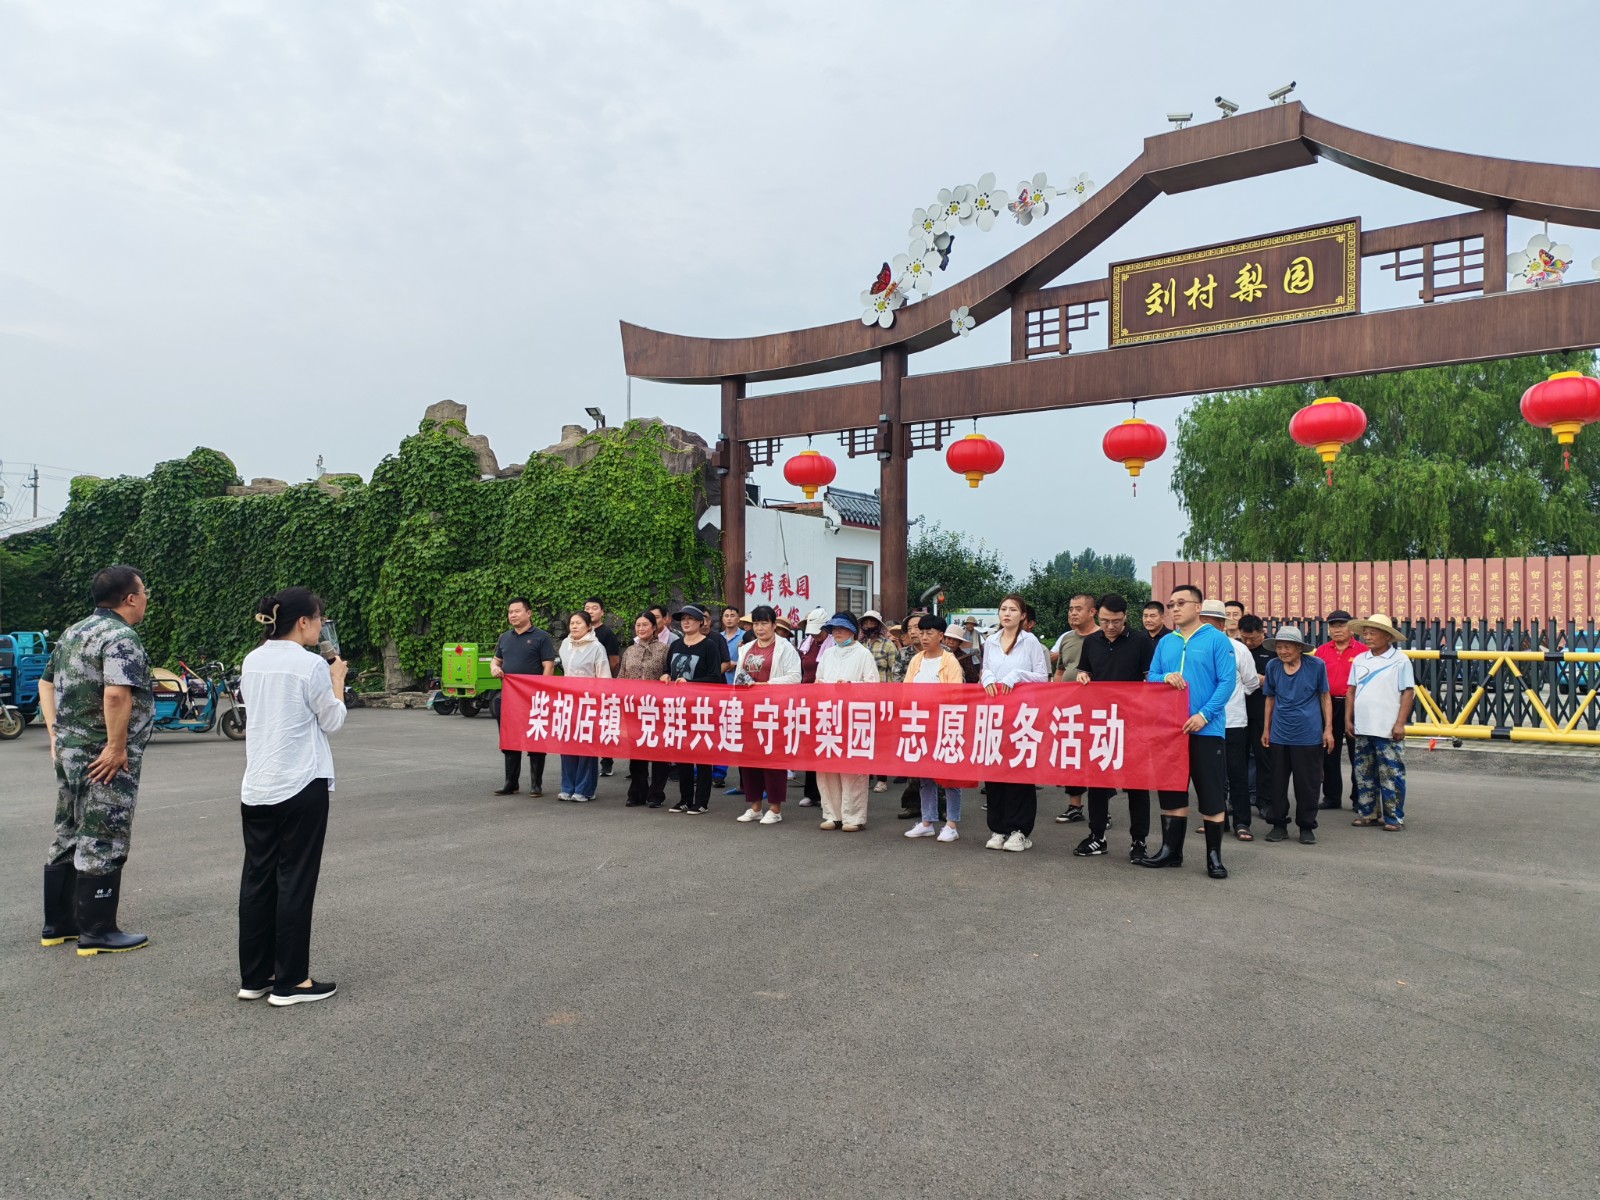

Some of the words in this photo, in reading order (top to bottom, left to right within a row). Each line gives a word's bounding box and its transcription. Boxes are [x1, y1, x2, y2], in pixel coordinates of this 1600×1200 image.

[1145, 256, 1314, 317] 刘村梨园
[1306, 574, 1317, 619] 蜂蝶恋花
[1413, 573, 1424, 620] 阳春三月
